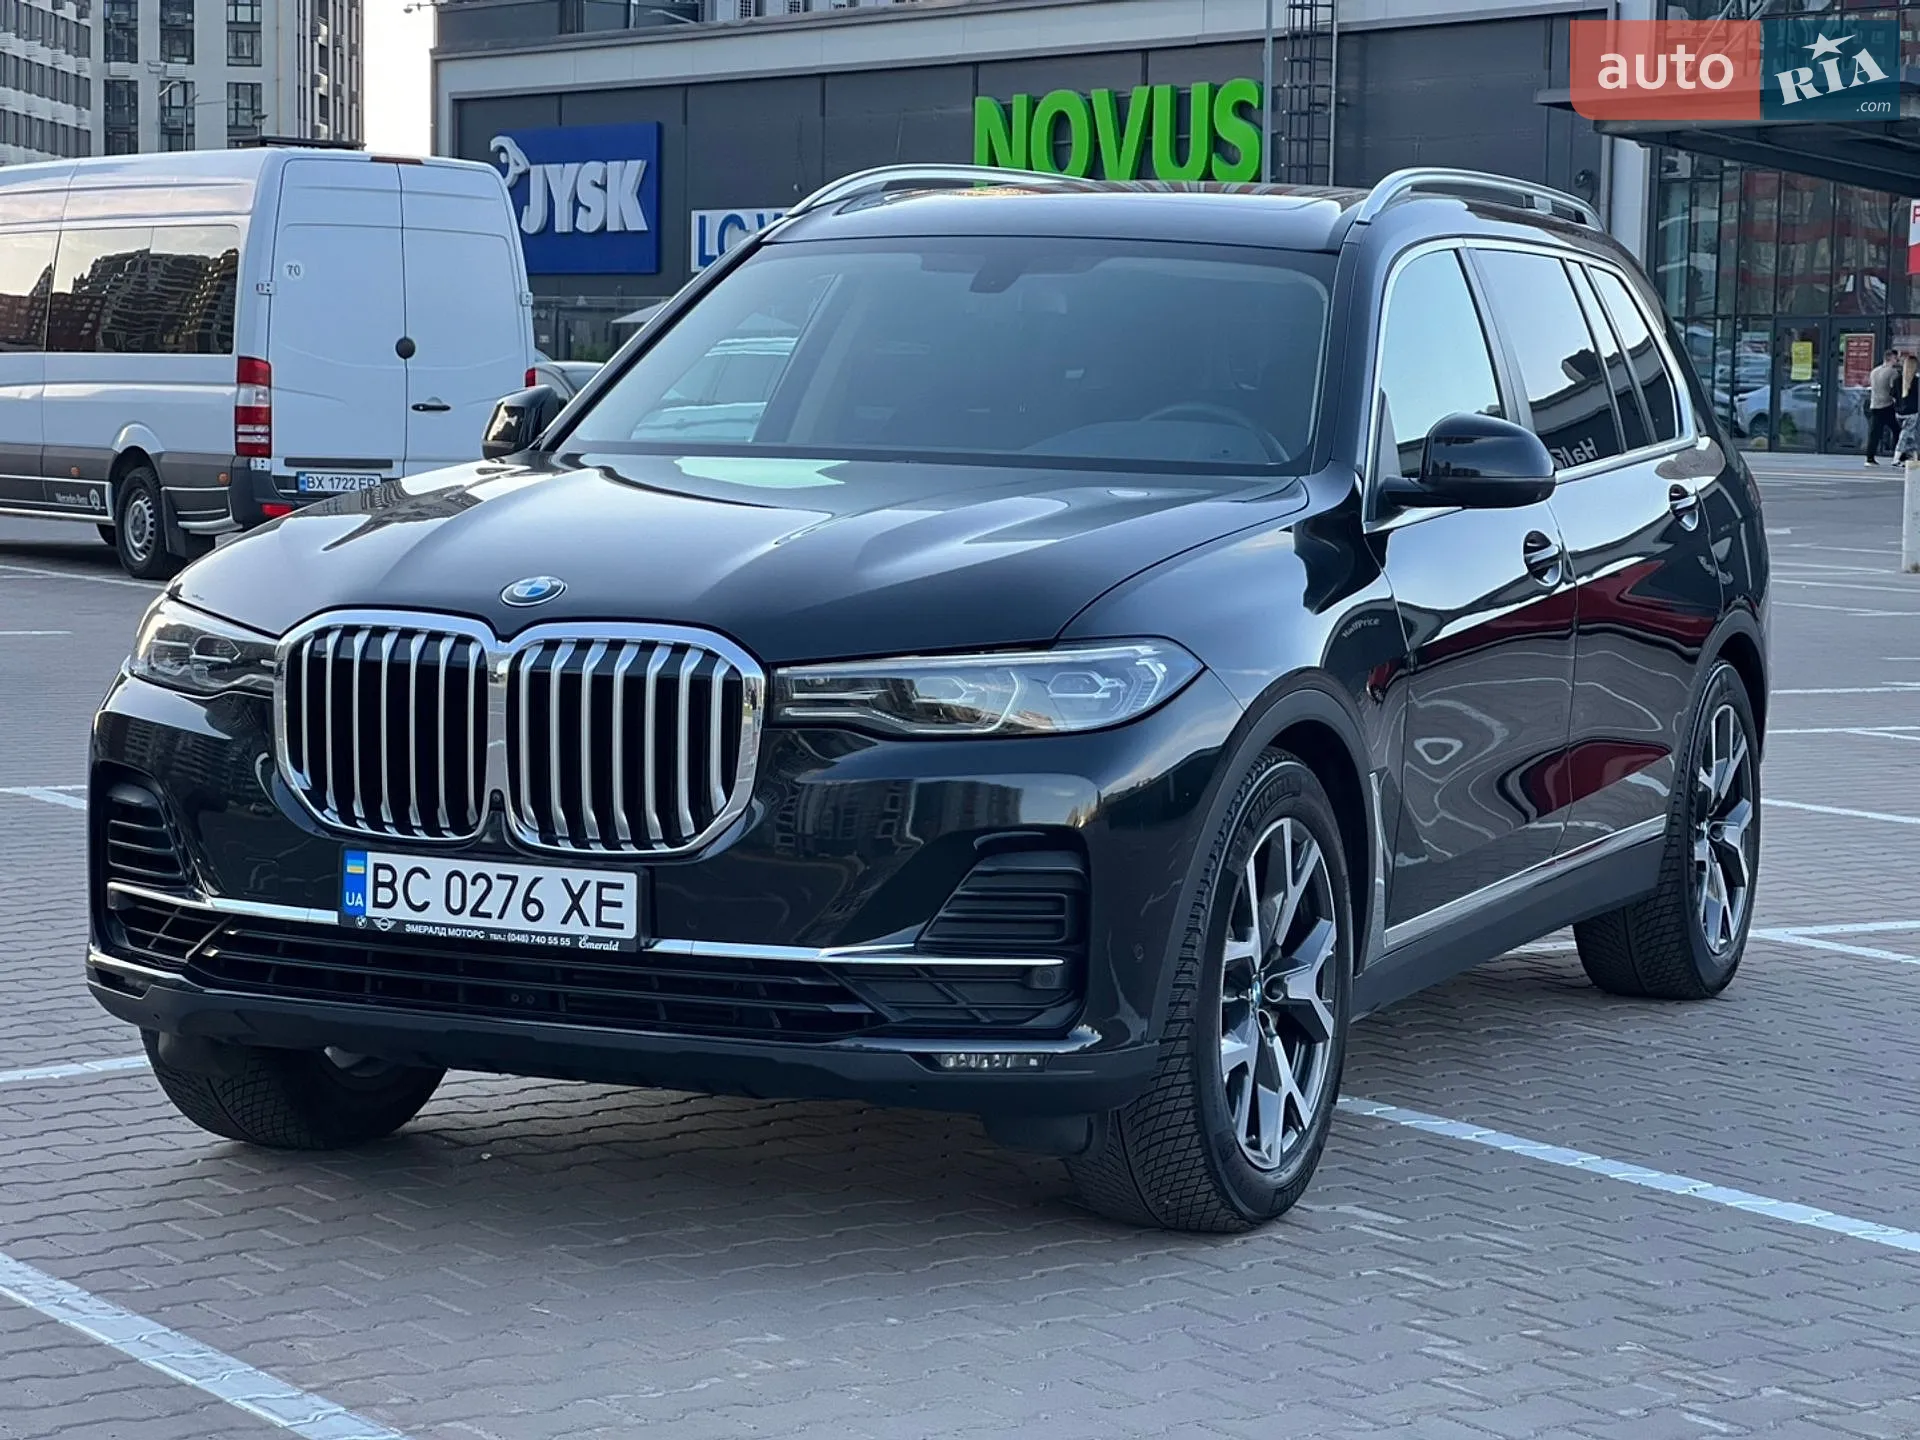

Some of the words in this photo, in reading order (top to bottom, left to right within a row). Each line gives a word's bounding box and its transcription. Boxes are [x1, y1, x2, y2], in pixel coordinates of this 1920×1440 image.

[974, 78, 1263, 185] NOVUS
[520, 160, 648, 235] JYSK
[286, 264, 301, 277] 70
[307, 476, 325, 489] BX
[328, 477, 356, 490] 1722
[345, 891, 364, 907] UA
[372, 862, 431, 913] BC
[445, 869, 545, 923] 0276
[560, 877, 625, 931] XE
[405, 923, 447, 937] ЭМЕРАЛД
[448, 927, 485, 939] МОТОРС
[531, 934, 547, 944] 740
[548, 936, 559, 945] 55
[560, 937, 571, 946] 55
[578, 934, 620, 951] Emerald
